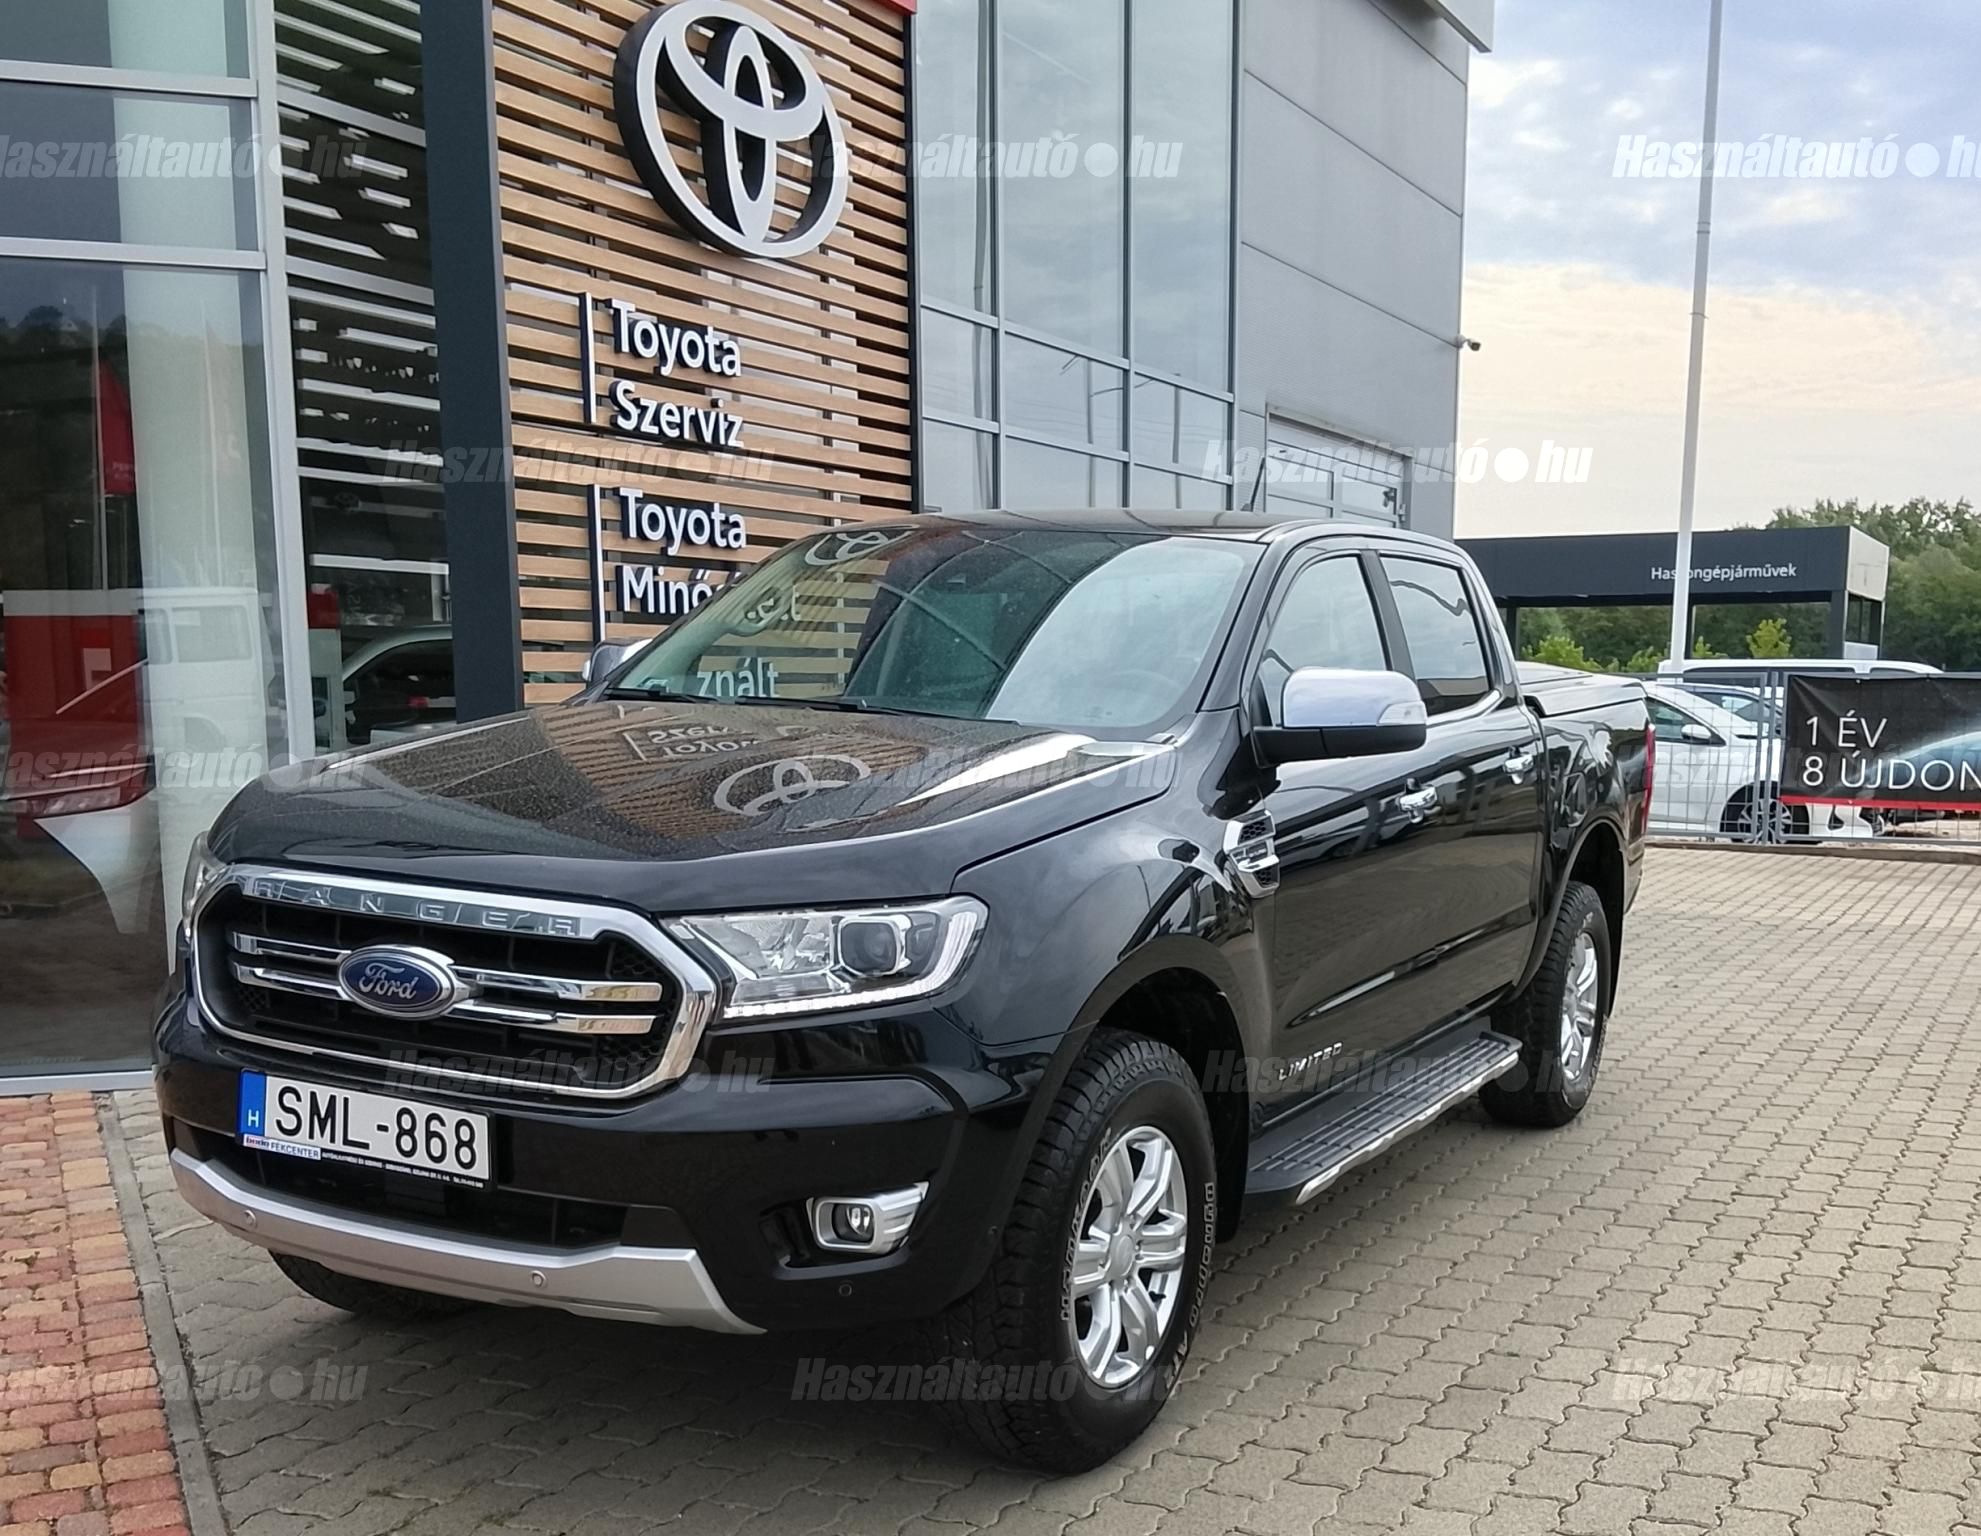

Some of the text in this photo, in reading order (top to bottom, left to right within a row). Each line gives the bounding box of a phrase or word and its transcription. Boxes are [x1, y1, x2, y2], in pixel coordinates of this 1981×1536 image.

[611, 299, 741, 377] Toyota
[615, 380, 744, 449] Szerviz
[620, 488, 746, 556] Toyota
[1651, 562, 1797, 581] Hasongépjárművek
[1806, 709, 1888, 748] 1 ÉV
[1803, 756, 1824, 787] 8
[253, 876, 579, 936] RANGER
[359, 962, 419, 1000] Ford
[1278, 1041, 1344, 1081] LIMITED
[247, 1108, 260, 1128] H
[275, 1085, 477, 1181] SML-868
